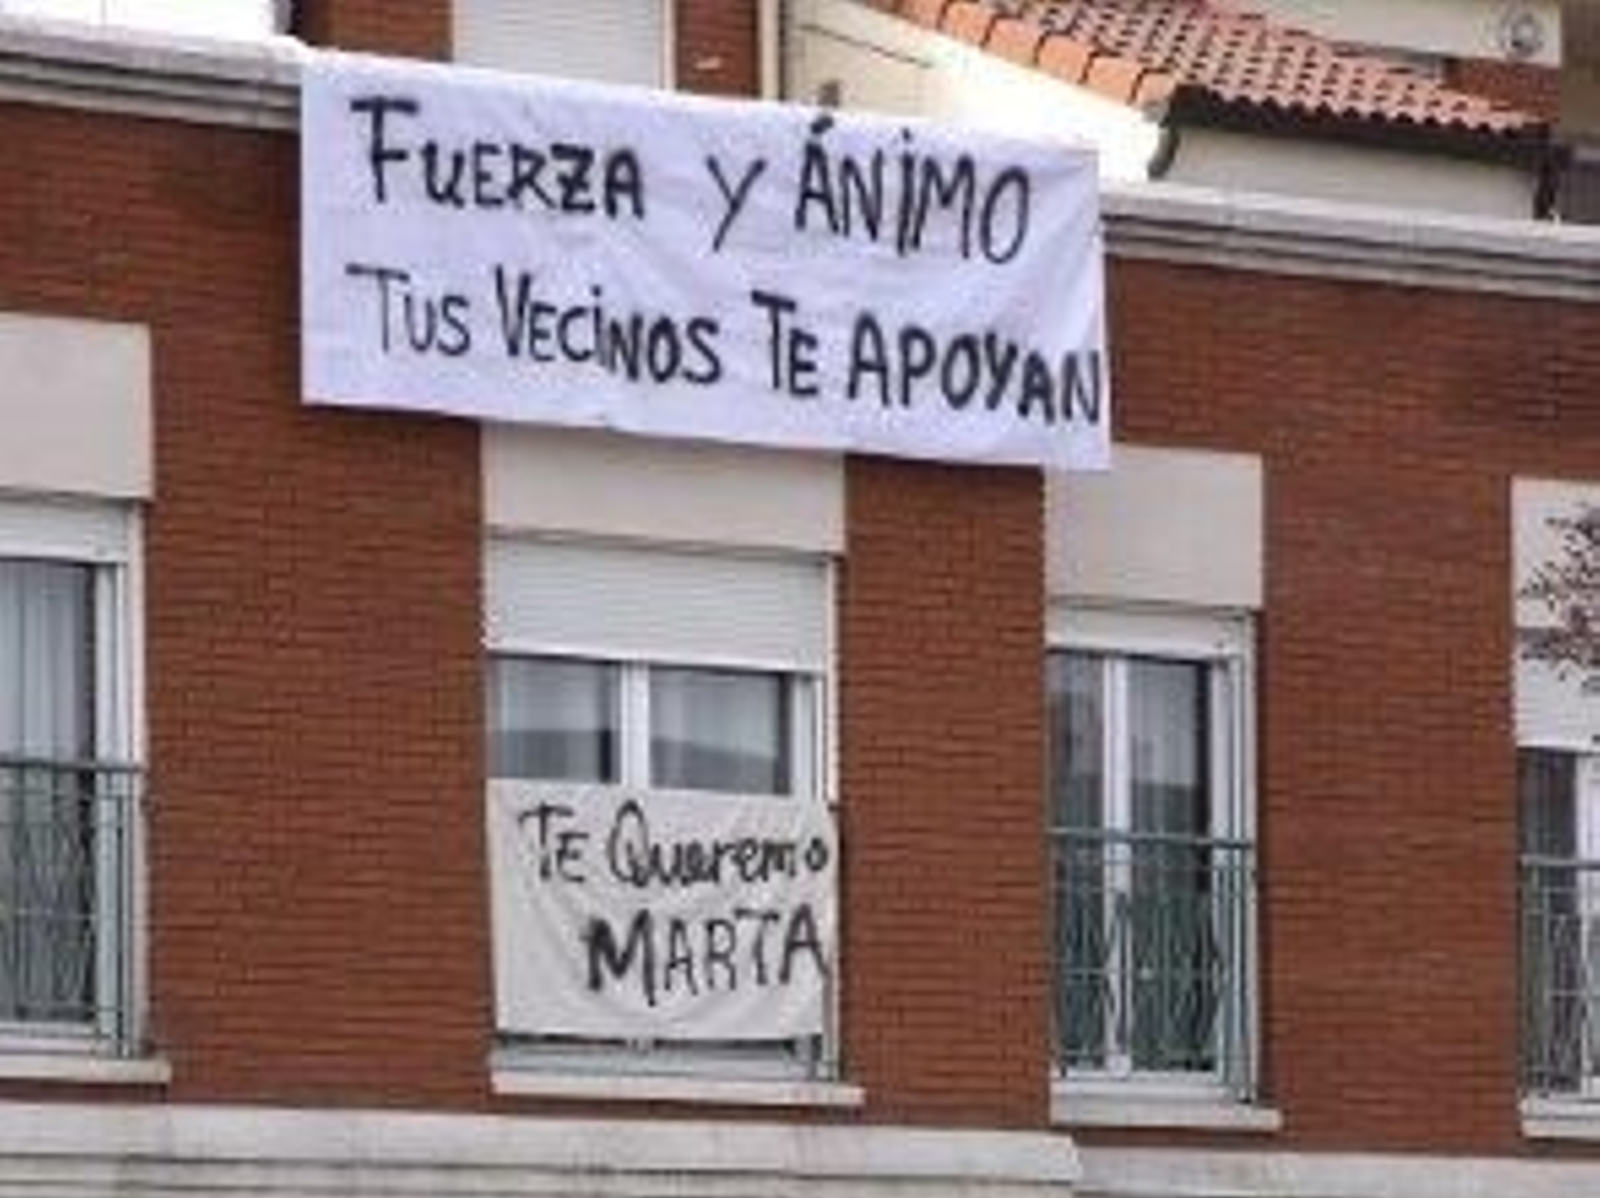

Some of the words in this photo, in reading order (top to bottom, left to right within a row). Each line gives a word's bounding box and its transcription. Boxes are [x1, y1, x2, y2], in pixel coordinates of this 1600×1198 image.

[345, 262, 472, 357] TUS
[750, 289, 820, 397] TE
[847, 311, 1101, 426] APOYAN
[518, 801, 591, 884] TE
[579, 902, 834, 1008] MARTA
